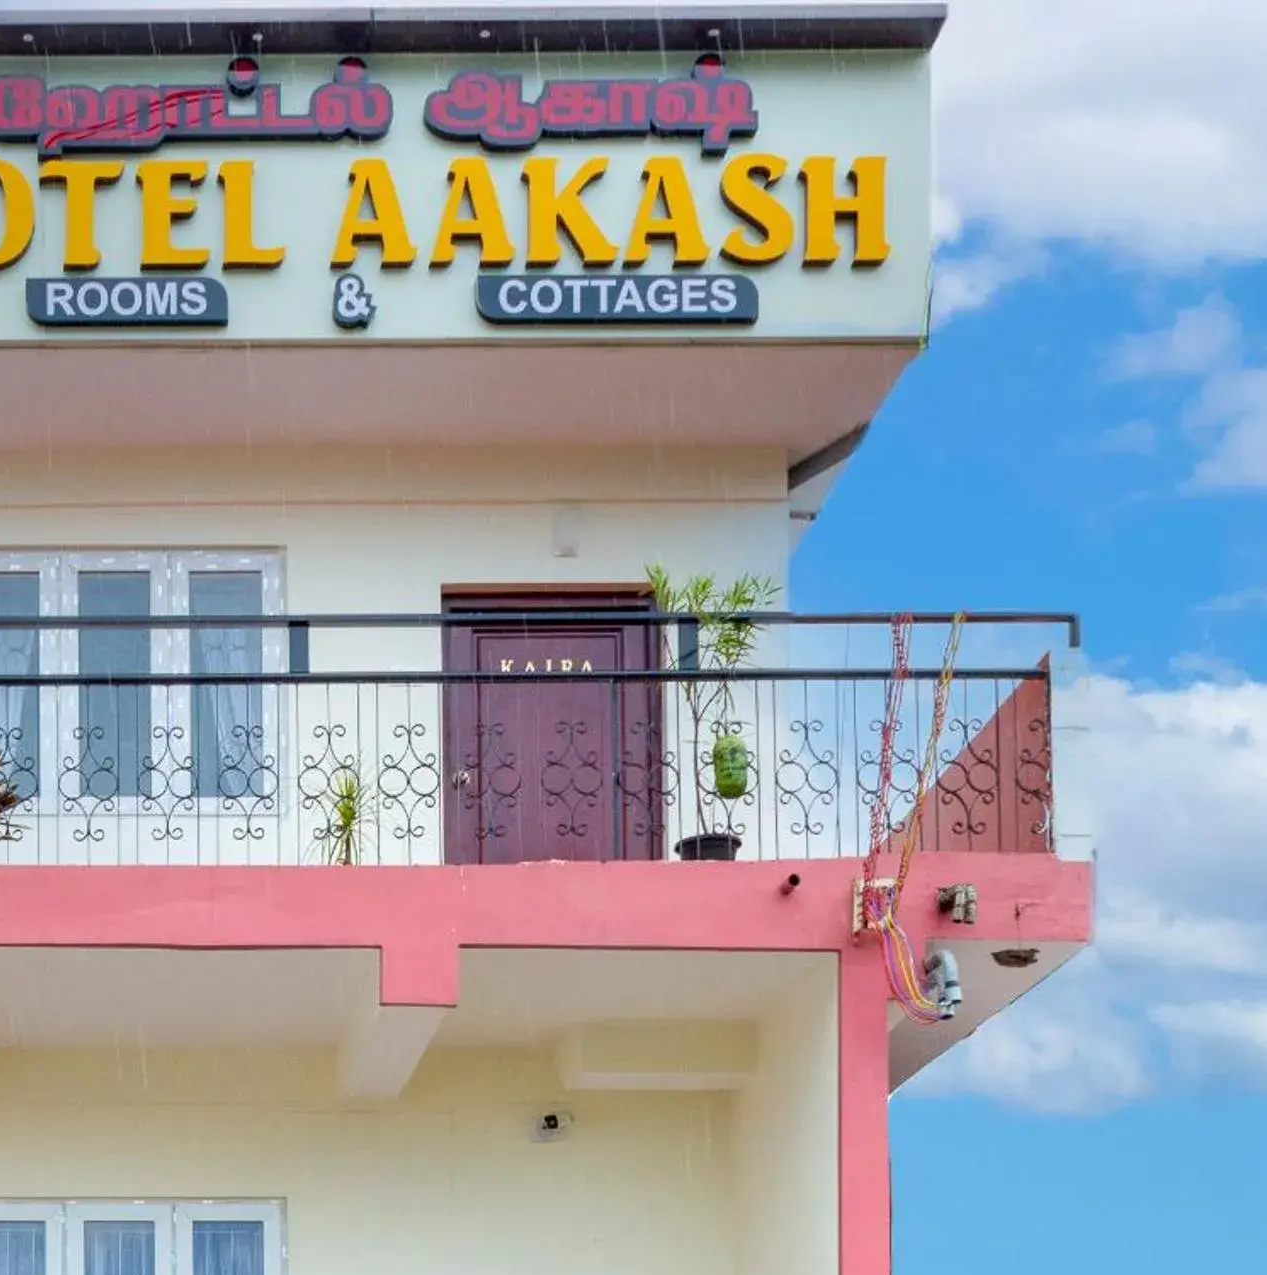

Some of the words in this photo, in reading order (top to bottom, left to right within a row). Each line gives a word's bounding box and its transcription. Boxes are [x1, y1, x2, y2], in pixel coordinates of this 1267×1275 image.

[430, 55, 756, 143] ஆகாஷ்
[330, 152, 893, 269] AAKASH
[45, 281, 208, 317] ROOMS
[336, 278, 374, 319] &
[498, 277, 739, 315] COTTAGES
